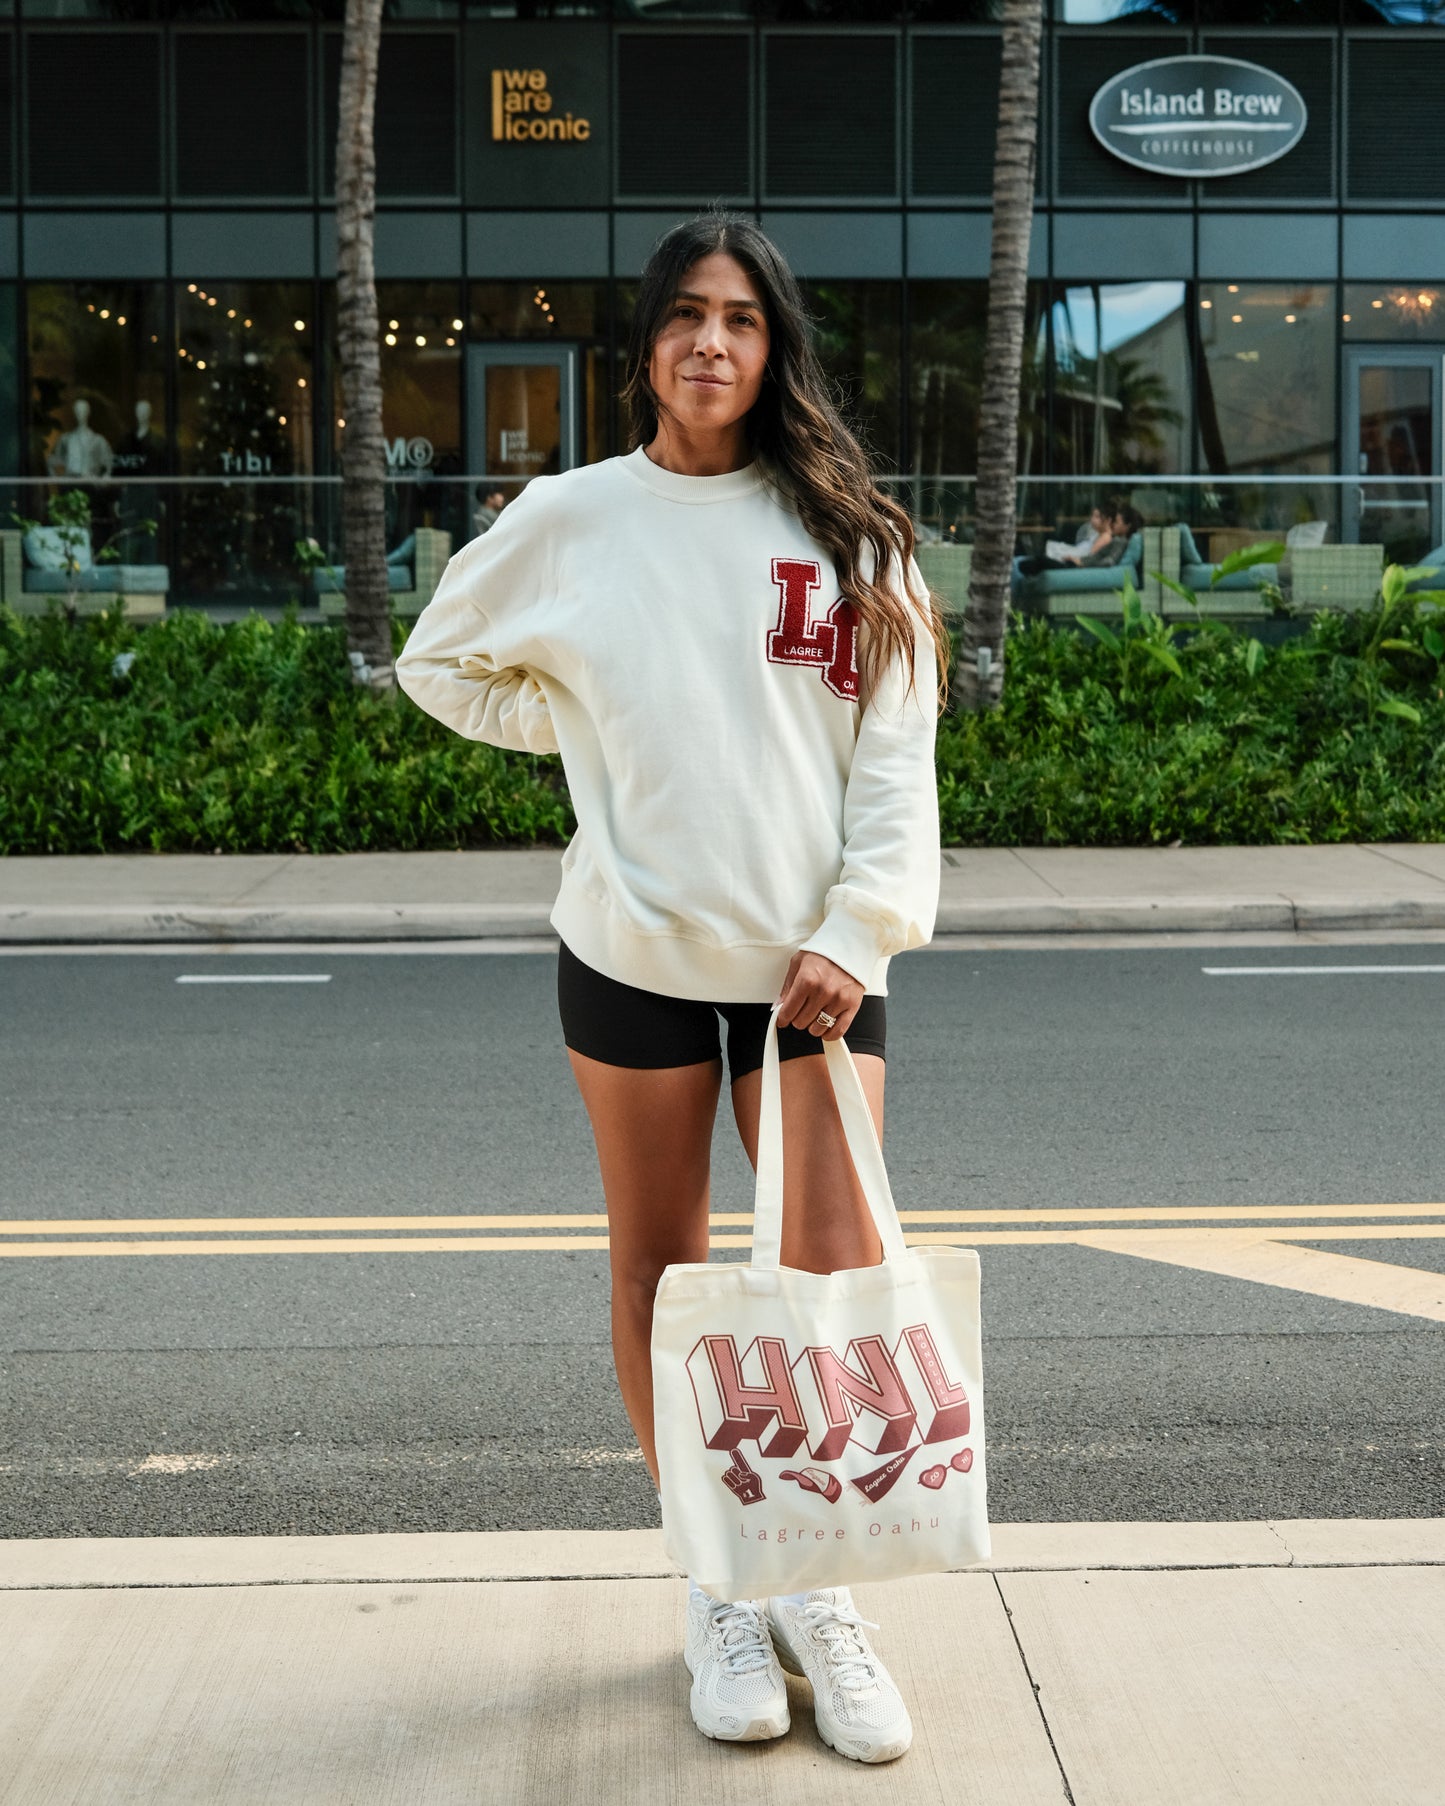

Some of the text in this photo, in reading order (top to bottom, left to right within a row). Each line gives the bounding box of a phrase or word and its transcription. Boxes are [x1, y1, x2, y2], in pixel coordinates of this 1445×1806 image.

[503, 69, 547, 90] we
[505, 91, 552, 113] are
[1120, 88, 1283, 116] Island Brew
[505, 112, 590, 141] iconic
[1140, 139, 1255, 156] COFFEEHOUSE
[784, 645, 823, 658] LAGREE
[843, 680, 855, 691] OA
[915, 1331, 950, 1405] HONOLULU
[686, 1323, 971, 1461] HNL
[740, 1516, 940, 1543] Lagree Oahu
